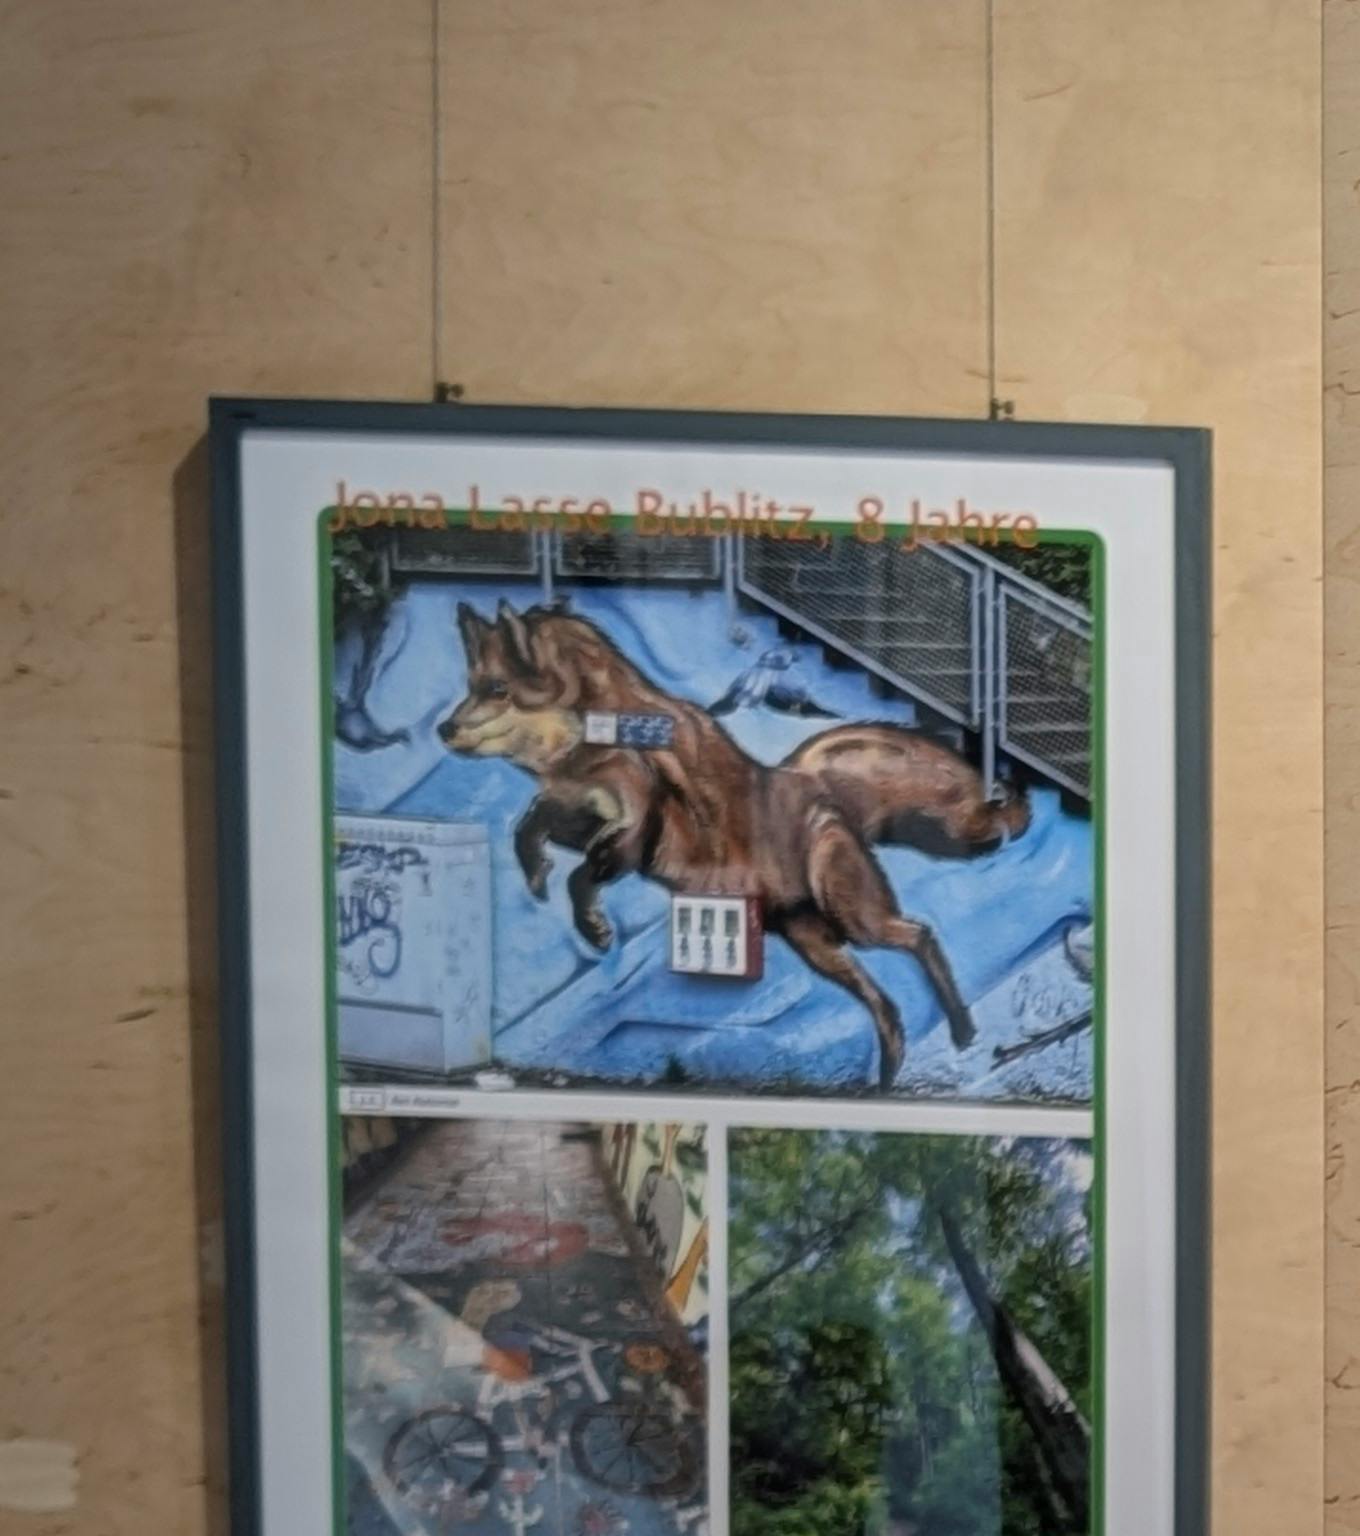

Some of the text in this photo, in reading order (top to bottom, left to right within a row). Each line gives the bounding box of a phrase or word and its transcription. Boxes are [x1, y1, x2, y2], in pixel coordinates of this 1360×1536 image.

[328, 480, 1039, 552] Jona Lasse Bublitz, 8 Jahre
